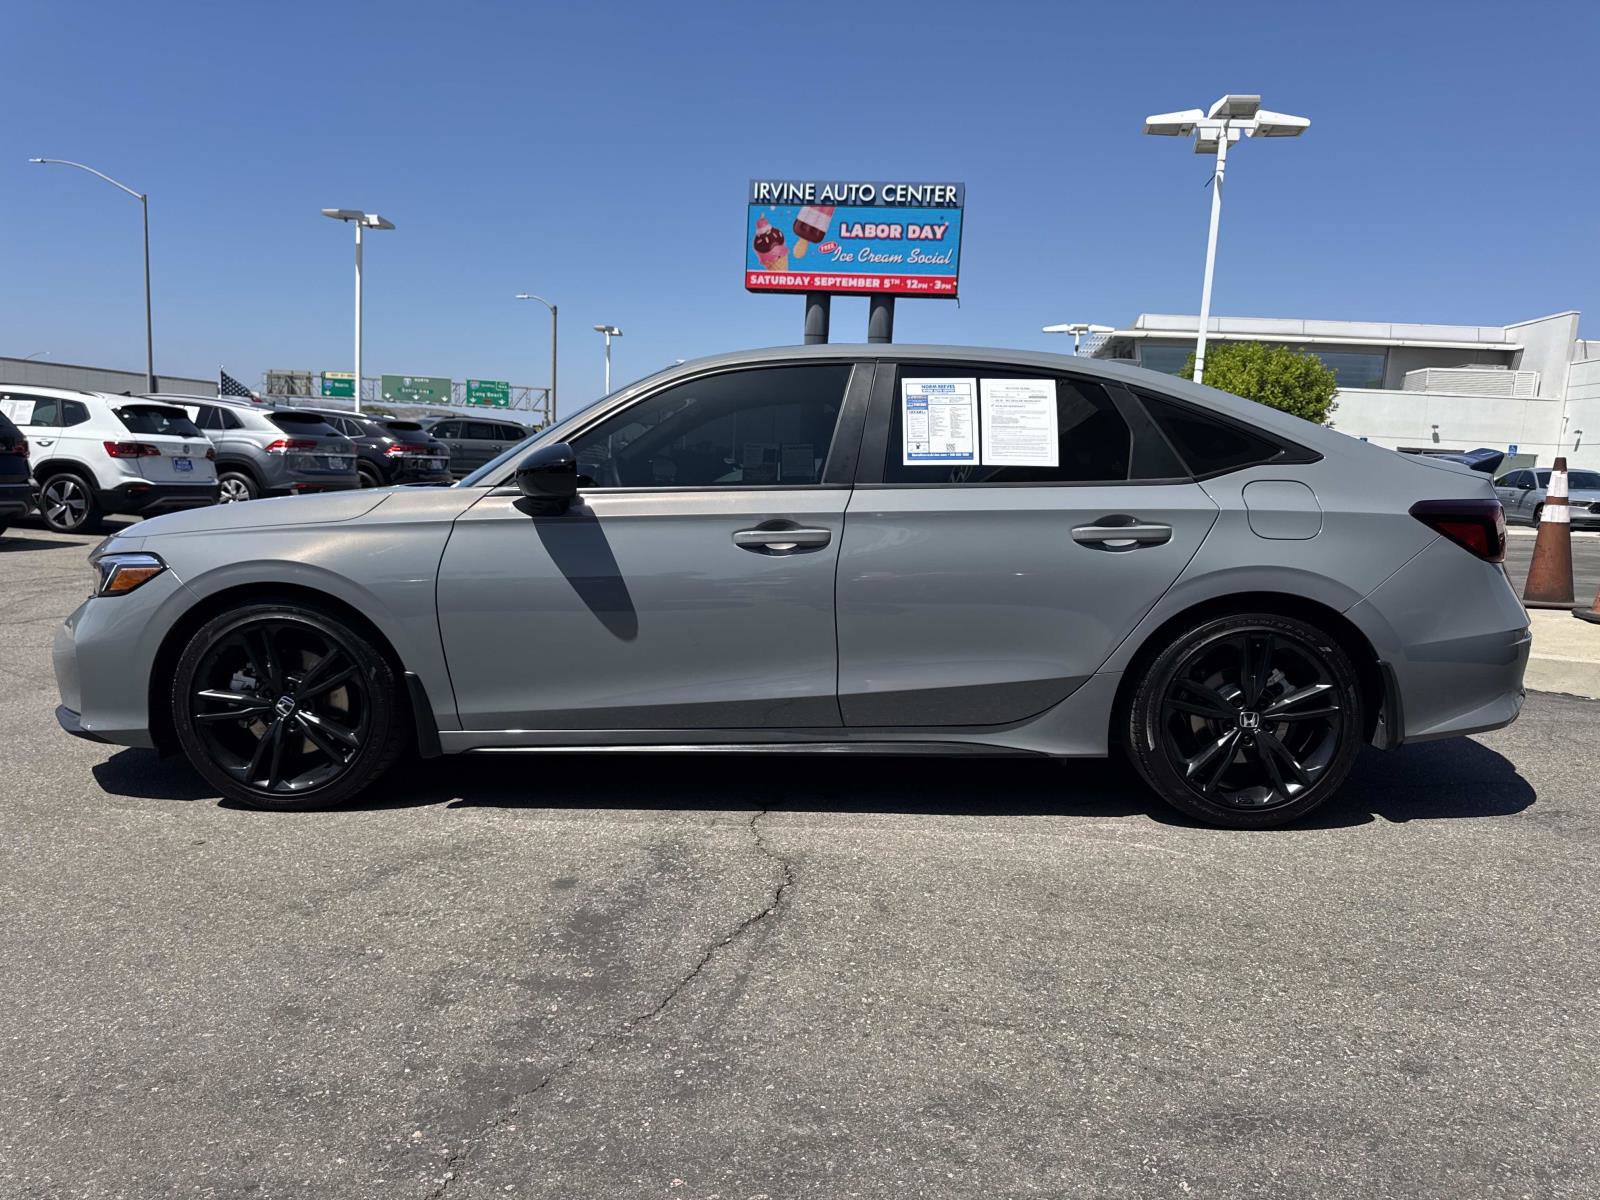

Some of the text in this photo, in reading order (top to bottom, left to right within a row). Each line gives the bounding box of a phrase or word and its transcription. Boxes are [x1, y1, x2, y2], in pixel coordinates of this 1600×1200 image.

[753, 182, 957, 203] IRVINE AUTO CENTER
[840, 223, 946, 240] LABOR DAY
[831, 245, 953, 264] Ice Cream Social
[750, 274, 811, 286] SATURDAY
[813, 276, 880, 289] SEPTEMBER
[883, 278, 900, 289] 5TH
[906, 279, 928, 290] 12PM
[934, 279, 952, 290] 3PM
